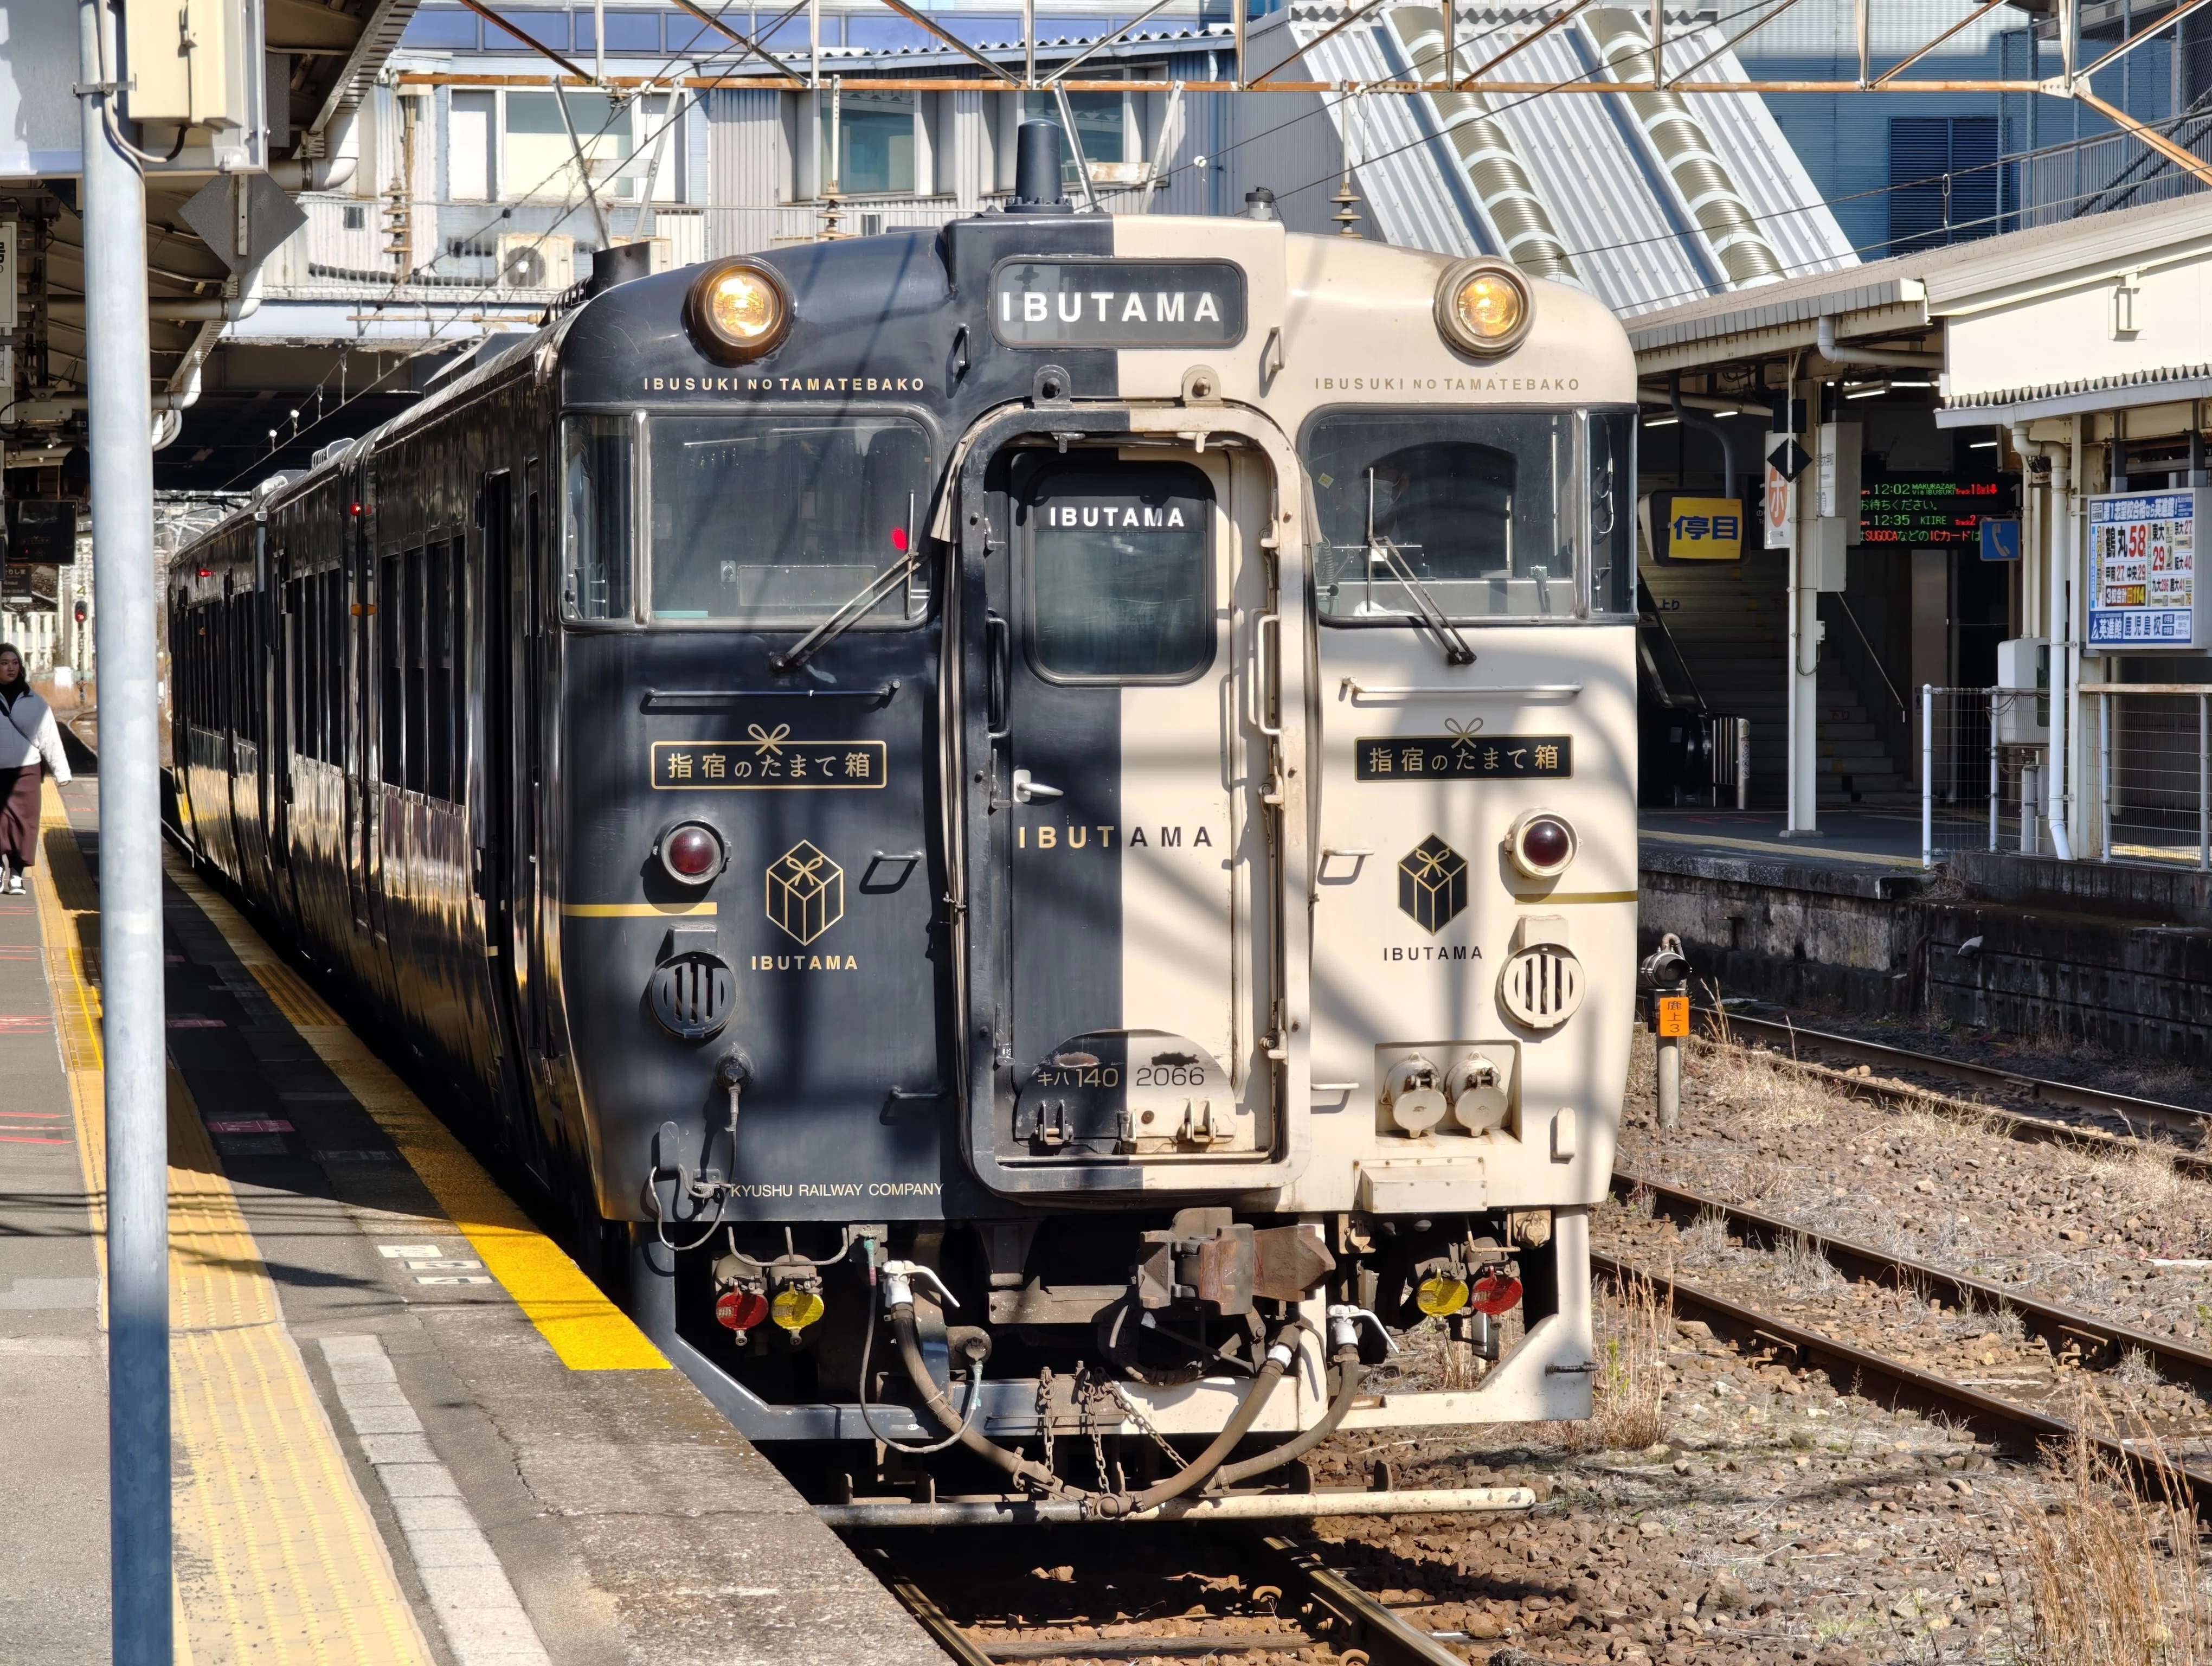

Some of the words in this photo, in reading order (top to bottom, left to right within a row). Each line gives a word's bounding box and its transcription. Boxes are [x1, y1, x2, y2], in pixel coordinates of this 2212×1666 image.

[1002, 292, 1220, 322] IBUTAMA
[644, 377, 738, 391] IBUSUKI
[748, 379, 772, 390] NO
[779, 377, 924, 391] TAMATEBAKO
[1315, 378, 1404, 390] IBUSUKI
[1413, 379, 1437, 389] NO
[1444, 378, 1580, 391] TAMATEBAKO
[1874, 483, 1910, 495] 12:02
[1861, 499, 1938, 511] お待ちください。
[1050, 507, 1185, 527] IBUTAMA
[1874, 515, 1910, 526] 12:35
[1920, 516, 1947, 525] KIIRE
[1970, 515, 1976, 526] 2
[2106, 525, 2128, 559] 鶴丸
[2129, 524, 2146, 558] 58
[2152, 523, 2165, 542] 東大
[2152, 546, 2165, 571] 29
[2116, 565, 2125, 582] 27
[2133, 586, 2145, 604] 114
[2125, 615, 2161, 636] 鹿児島校
[667, 751, 870, 779] 指宿のたまて箱
[1369, 744, 1559, 773] 指宿のたまて箱
[1019, 825, 1213, 848] IBUTAMA
[1384, 945, 1483, 961] IBUTAMA
[751, 955, 858, 971] IBUTAMA
[1667, 1000, 1683, 1033] 鹿上3
[1136, 1067, 1205, 1086] 2066
[731, 1184, 793, 1197] KYUSHU
[799, 1183, 863, 1197] RAILWAY
[869, 1182, 944, 1196] COMPANY
